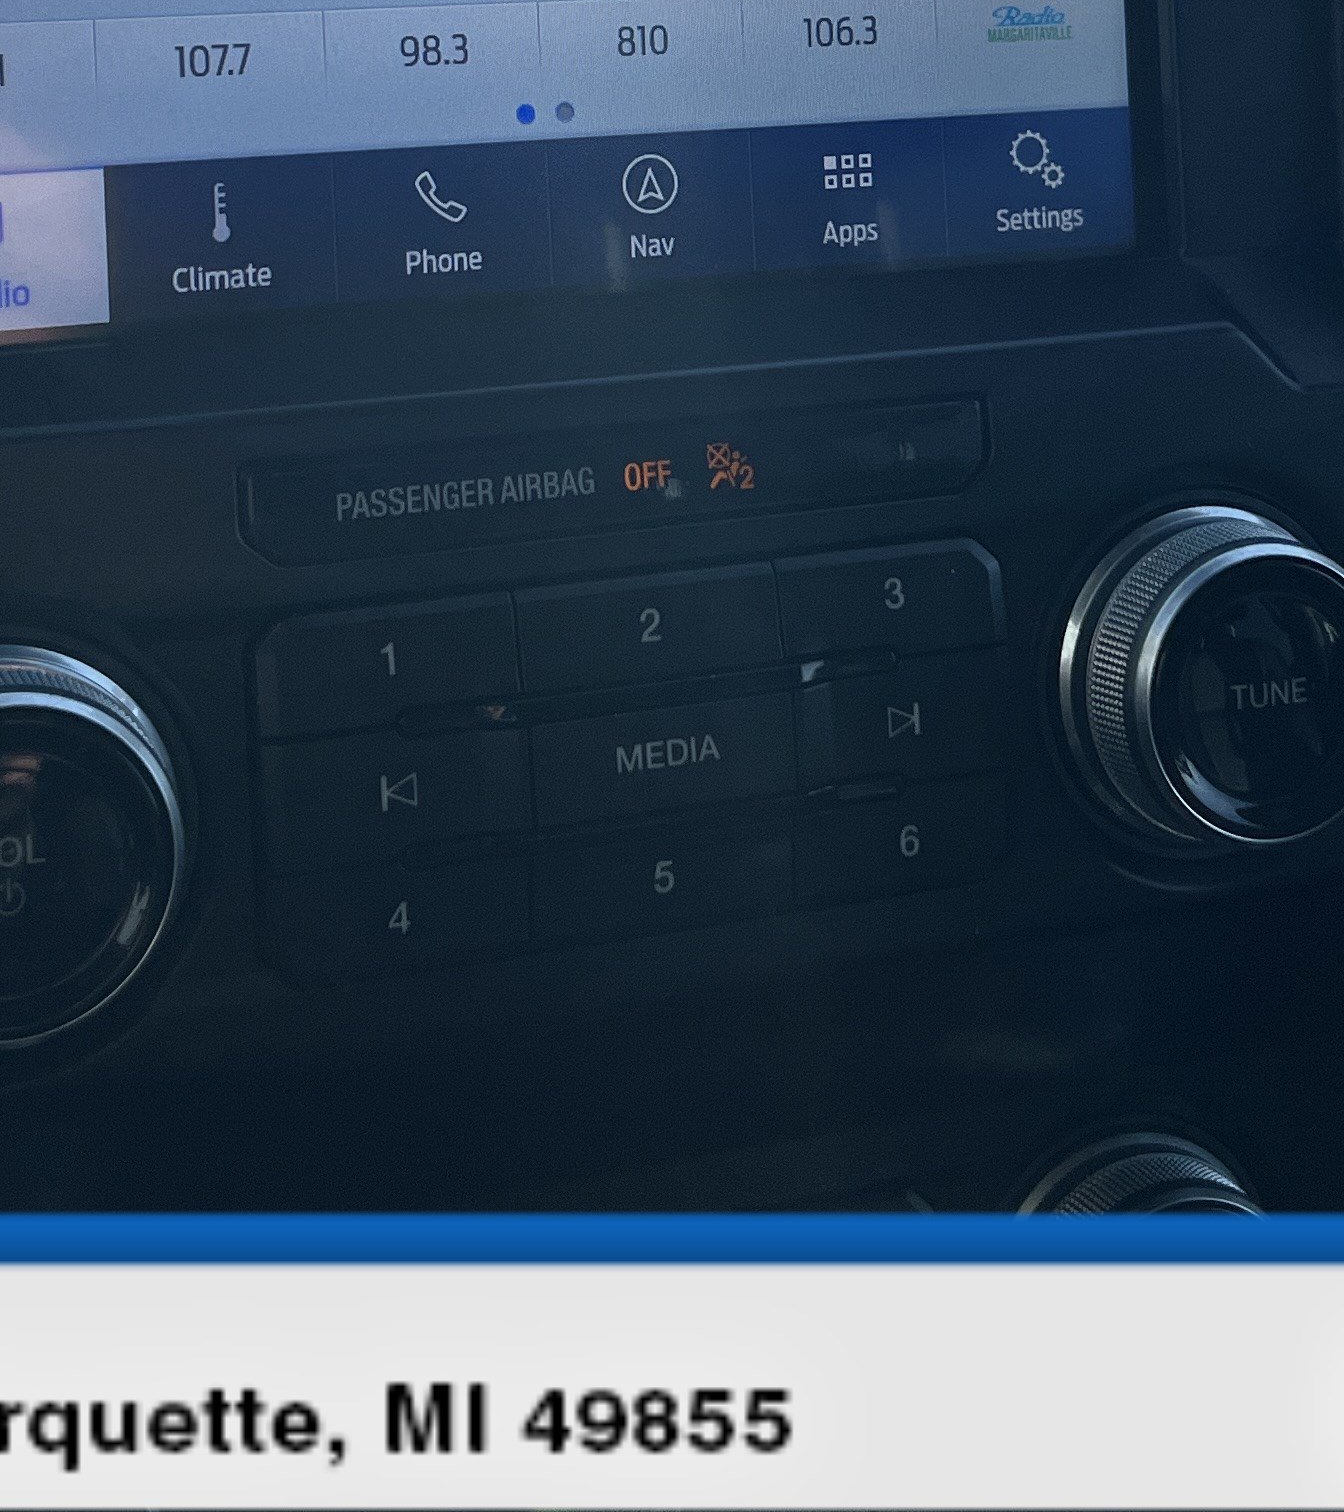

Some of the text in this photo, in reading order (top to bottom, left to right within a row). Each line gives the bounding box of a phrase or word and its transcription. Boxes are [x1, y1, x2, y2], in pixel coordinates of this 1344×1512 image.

[804, 16, 877, 47] 106.3
[992, 5, 1067, 27] Radio
[618, 25, 668, 56] 810
[987, 25, 1072, 43] MARGARITAVILLE
[175, 44, 250, 77] 107.7
[401, 34, 468, 66] 98.3
[824, 221, 878, 246] Apps
[997, 207, 1083, 231] Settings
[407, 249, 482, 274] Phone
[631, 235, 674, 257] Nav
[173, 264, 271, 292] Climate
[337, 460, 672, 520] PASSENGER AIRBAG OFF
[885, 578, 904, 609] 3
[640, 609, 661, 642] 2
[382, 643, 395, 674] 1
[1231, 678, 1306, 709] TUNE
[617, 735, 719, 772] MEDIA
[900, 826, 919, 856] 6
[655, 861, 674, 892] 5
[389, 902, 410, 932] 4
